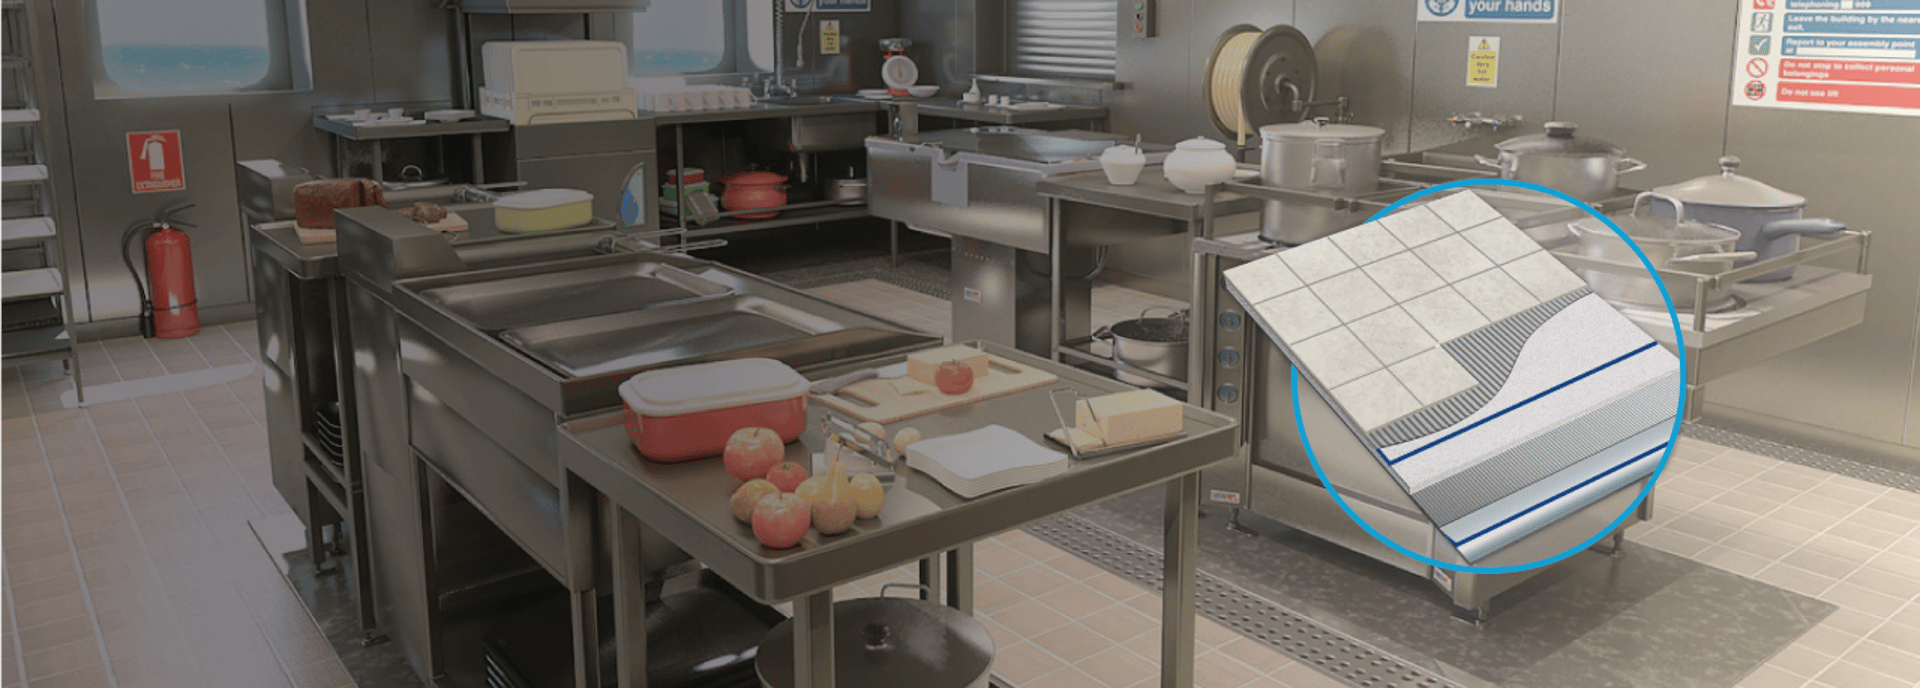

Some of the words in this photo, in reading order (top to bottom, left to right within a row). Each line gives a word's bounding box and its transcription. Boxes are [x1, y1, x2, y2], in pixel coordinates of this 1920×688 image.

[1468, 0, 1501, 15] your
[1505, 0, 1551, 12] hands
[1830, 15, 1866, 25] building
[1867, 16, 1878, 25] by
[1786, 38, 1814, 47] Report
[1826, 40, 1846, 49] your
[1847, 40, 1890, 50] assembly
[1891, 41, 1915, 50] point
[1813, 62, 1831, 70] stop
[1844, 63, 1873, 71] collect
[1874, 64, 1915, 73] personal
[1783, 69, 1829, 79] belongings
[1781, 87, 1793, 95] Do
